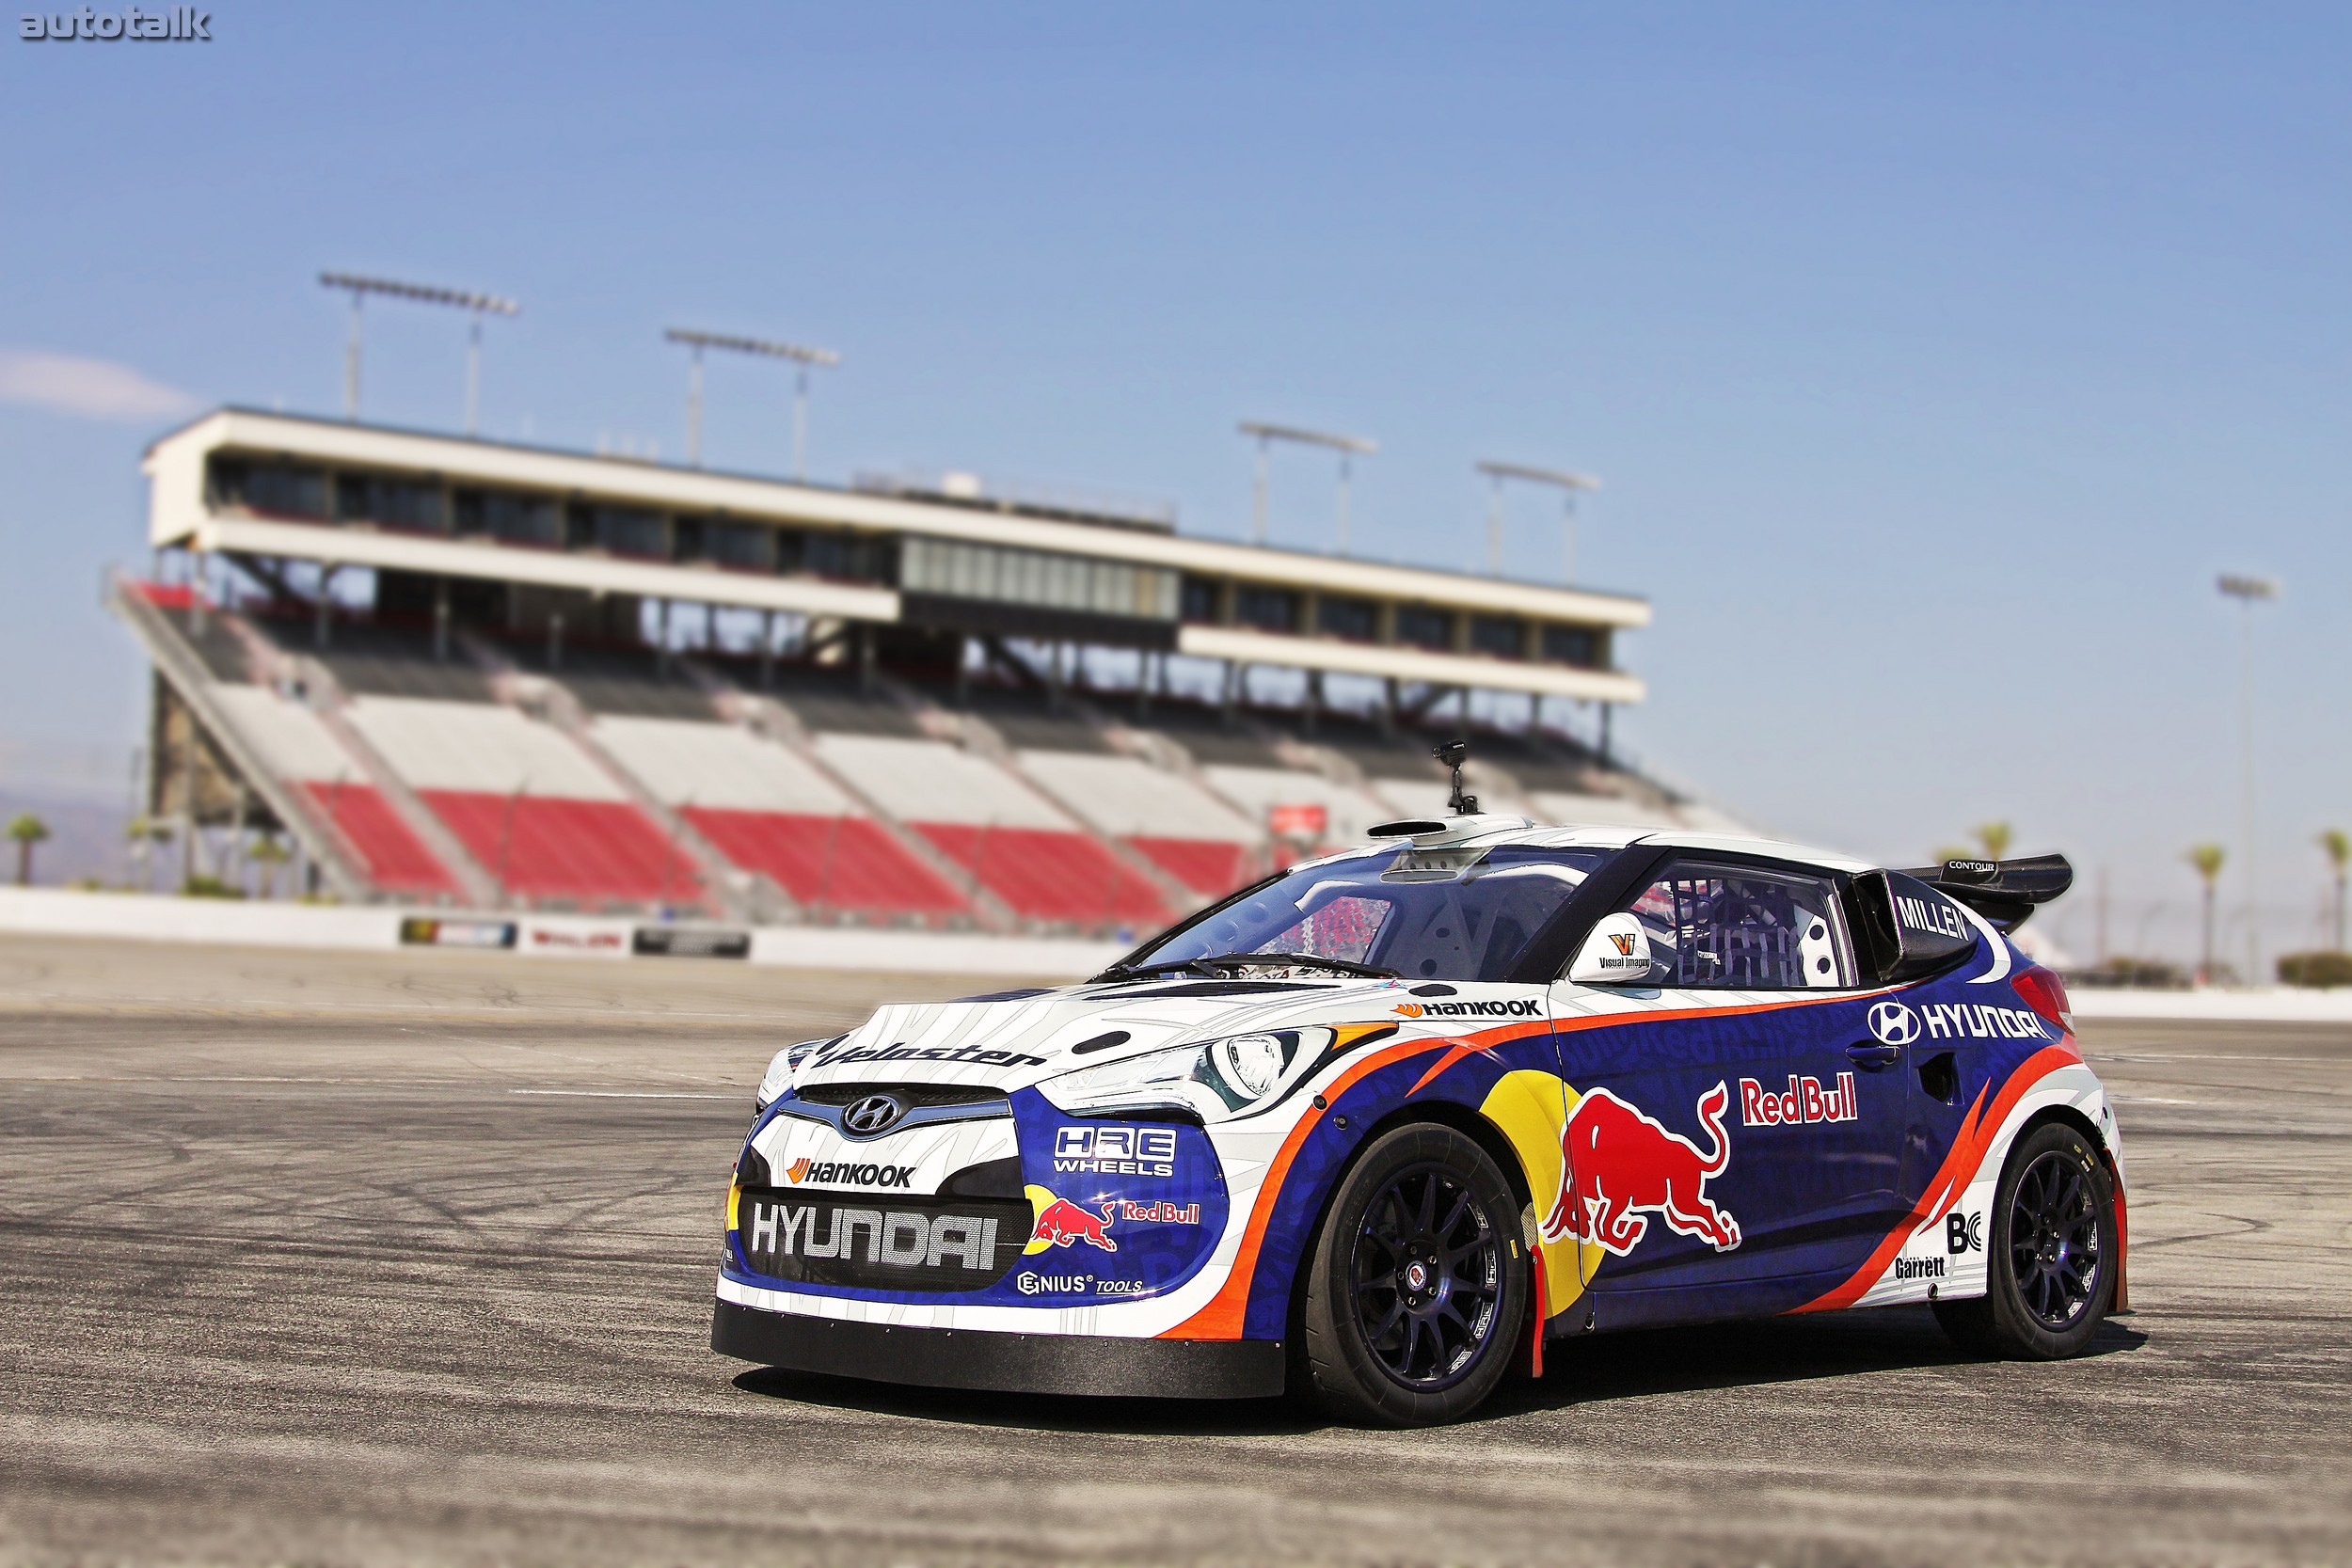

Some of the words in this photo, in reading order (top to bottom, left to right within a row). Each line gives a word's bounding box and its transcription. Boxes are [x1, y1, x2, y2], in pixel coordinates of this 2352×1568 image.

[1948, 861, 1994, 871] CONTOUR
[1896, 895, 1969, 942] MILLEN
[1599, 957, 1625, 969] Visual
[1920, 1004, 2053, 1040] HYUNDAI
[810, 1034, 1048, 1069] Veloster
[1740, 1073, 1803, 1126] Red
[1800, 1070, 1858, 1124] Bull
[1054, 1126, 1176, 1163] HRE
[1053, 1159, 1174, 1177] WHEELS
[1121, 1200, 1161, 1223] Red
[1162, 1202, 1200, 1225] Bull
[752, 1201, 999, 1271] HYUNDAI
[1946, 1211, 1982, 1255] BC
[1895, 1257, 1946, 1280] Garrett
[1095, 1280, 1143, 1295] TOOLS
[1474, 1302, 1494, 1338] HRE
